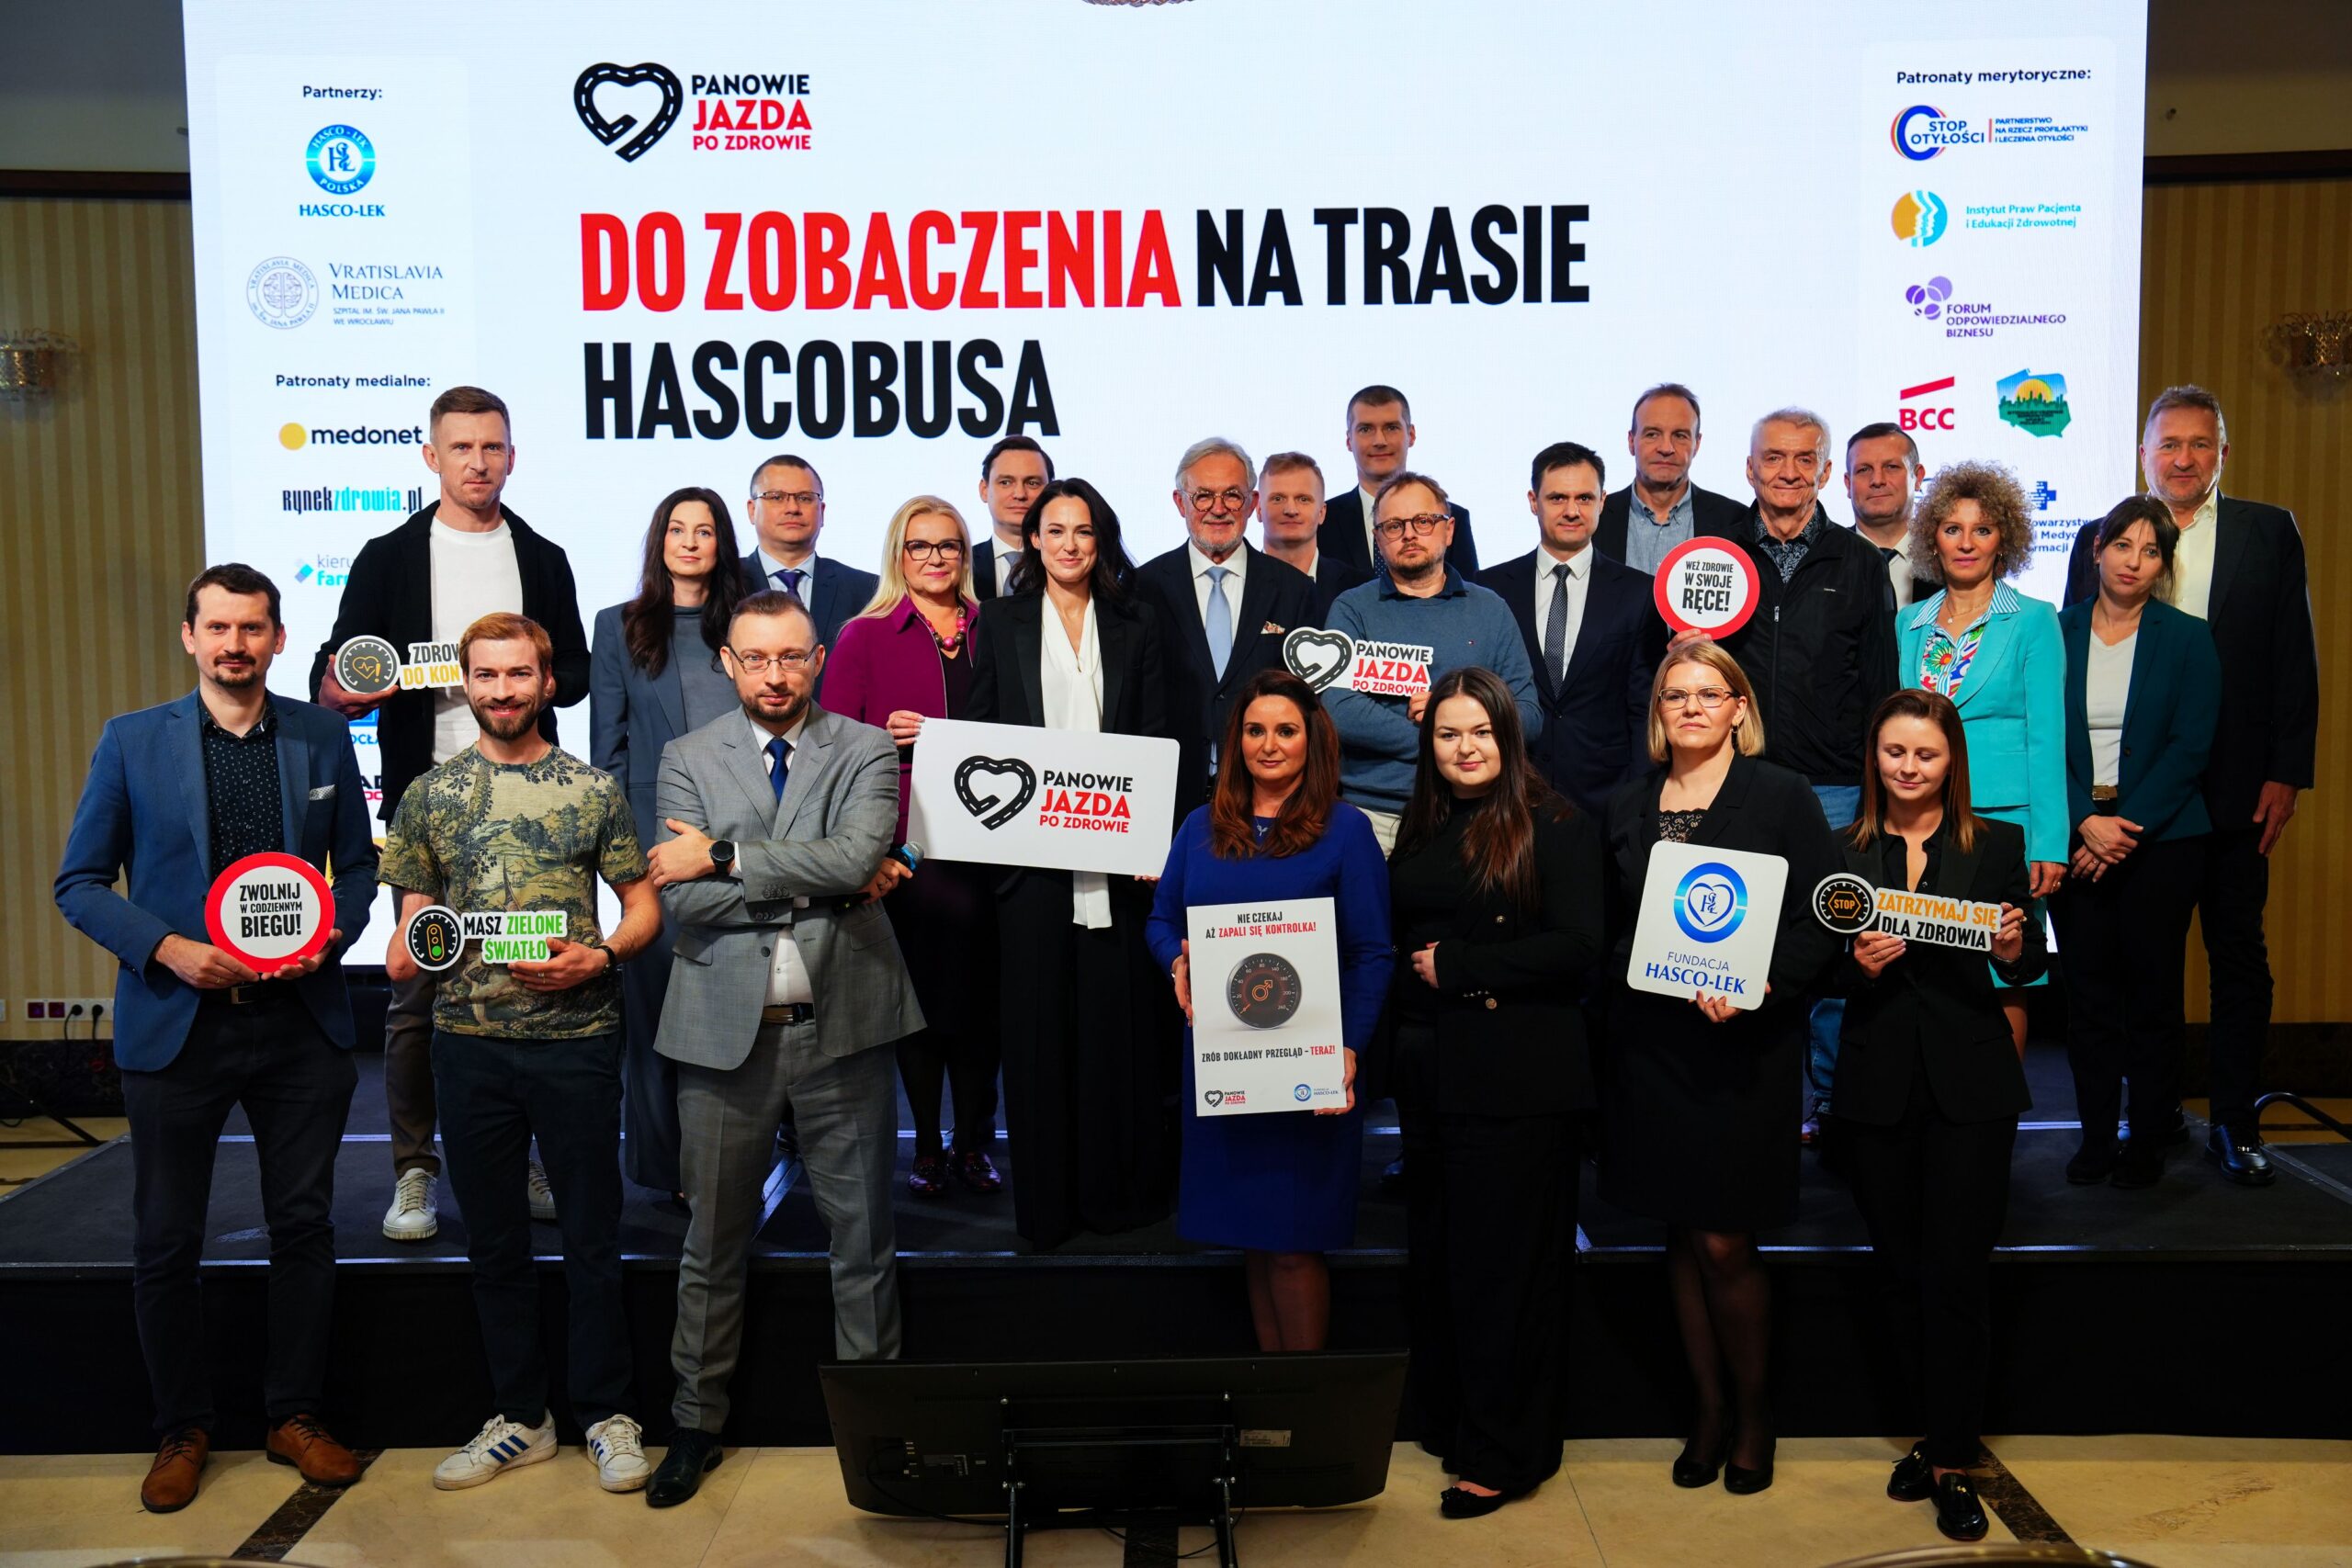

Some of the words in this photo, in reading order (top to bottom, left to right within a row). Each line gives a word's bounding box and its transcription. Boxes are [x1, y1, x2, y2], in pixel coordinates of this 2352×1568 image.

[692, 73, 810, 96] PANOWIE
[1896, 72, 1973, 85] Patronaty
[1977, 69, 2091, 83] merytoryczne:
[303, 85, 382, 100] Partnerzy:
[693, 99, 812, 131] JAZDA
[1928, 121, 1968, 132] STOP
[693, 135, 718, 151] PO
[724, 134, 812, 151] ZDROWIE
[1911, 130, 1984, 144] OTYŁOŚCI
[320, 178, 364, 193] POLSKA
[300, 204, 386, 217] HASCO-LEK
[1966, 204, 2007, 215] Instytut
[2008, 204, 2036, 213] Praw
[2038, 202, 2082, 214] Pacjenta
[1972, 219, 2014, 230] Edukacji
[2016, 217, 2076, 228] Zdrowotnej
[580, 210, 686, 312] DO
[704, 209, 1182, 312] ZOBACZENIA
[1196, 208, 1303, 307] NA
[1314, 203, 1589, 306] TRASIE
[329, 263, 443, 279] VRATISLAVIA
[332, 284, 404, 299] MEDICA
[1948, 303, 1992, 314] FORUM
[1946, 314, 2066, 325] ODPOWIEDZIALNEGO
[1946, 328, 1994, 338] BIZNESU
[276, 375, 350, 389] Patronaty
[356, 375, 431, 387] medialne:
[583, 338, 1060, 441] HASCOBUSA
[1898, 408, 1955, 430] BCC
[311, 426, 423, 445] medonet
[1702, 562, 1734, 573] ZDROWIE
[1685, 572, 1694, 586] W
[1696, 573, 1733, 588] SWOJE
[1682, 588, 1731, 614] RĘCE!
[1356, 643, 1430, 662] PANOWIE
[403, 665, 424, 685] DO
[1354, 658, 1428, 683] JAZDA
[1352, 680, 1369, 691] PO
[1043, 770, 1134, 793] PANOWIE
[1040, 788, 1131, 819] JAZDA
[1040, 815, 1060, 827] PO
[1063, 817, 1128, 833] ZDROWIE
[239, 882, 300, 902] ZWOLNIJ
[241, 904, 247, 913] W
[250, 902, 302, 913] CODZIENNYM
[1834, 898, 1856, 909] STOP
[1876, 892, 1968, 922] ZATRZYMAJ
[1973, 907, 1999, 930] SIĘ
[241, 914, 301, 938] BIEGU!
[465, 916, 502, 935] MASZ
[507, 915, 562, 935] ZIELONE
[1237, 913, 1250, 924] NIE
[1253, 911, 1283, 922] CZEKAJ
[1205, 928, 1216, 939] AŻ
[1218, 926, 1246, 937] ZAPALI
[1250, 925, 1262, 937] SIĘ
[1266, 922, 1316, 935] KONTROLKA!
[1883, 916, 1911, 937] DLA
[1916, 921, 1986, 948] ZDROWIA
[485, 938, 547, 961] ŚWIATŁO
[1667, 952, 1730, 972] FUNDACJA
[1645, 963, 1747, 994] HASCO-LEK
[1202, 1051, 1220, 1062] ZRÓB
[1224, 1049, 1262, 1061] DOKŁADNY
[1266, 1047, 1303, 1058] PRZEGLĄD
[1310, 1045, 1336, 1055] TERAZ!
